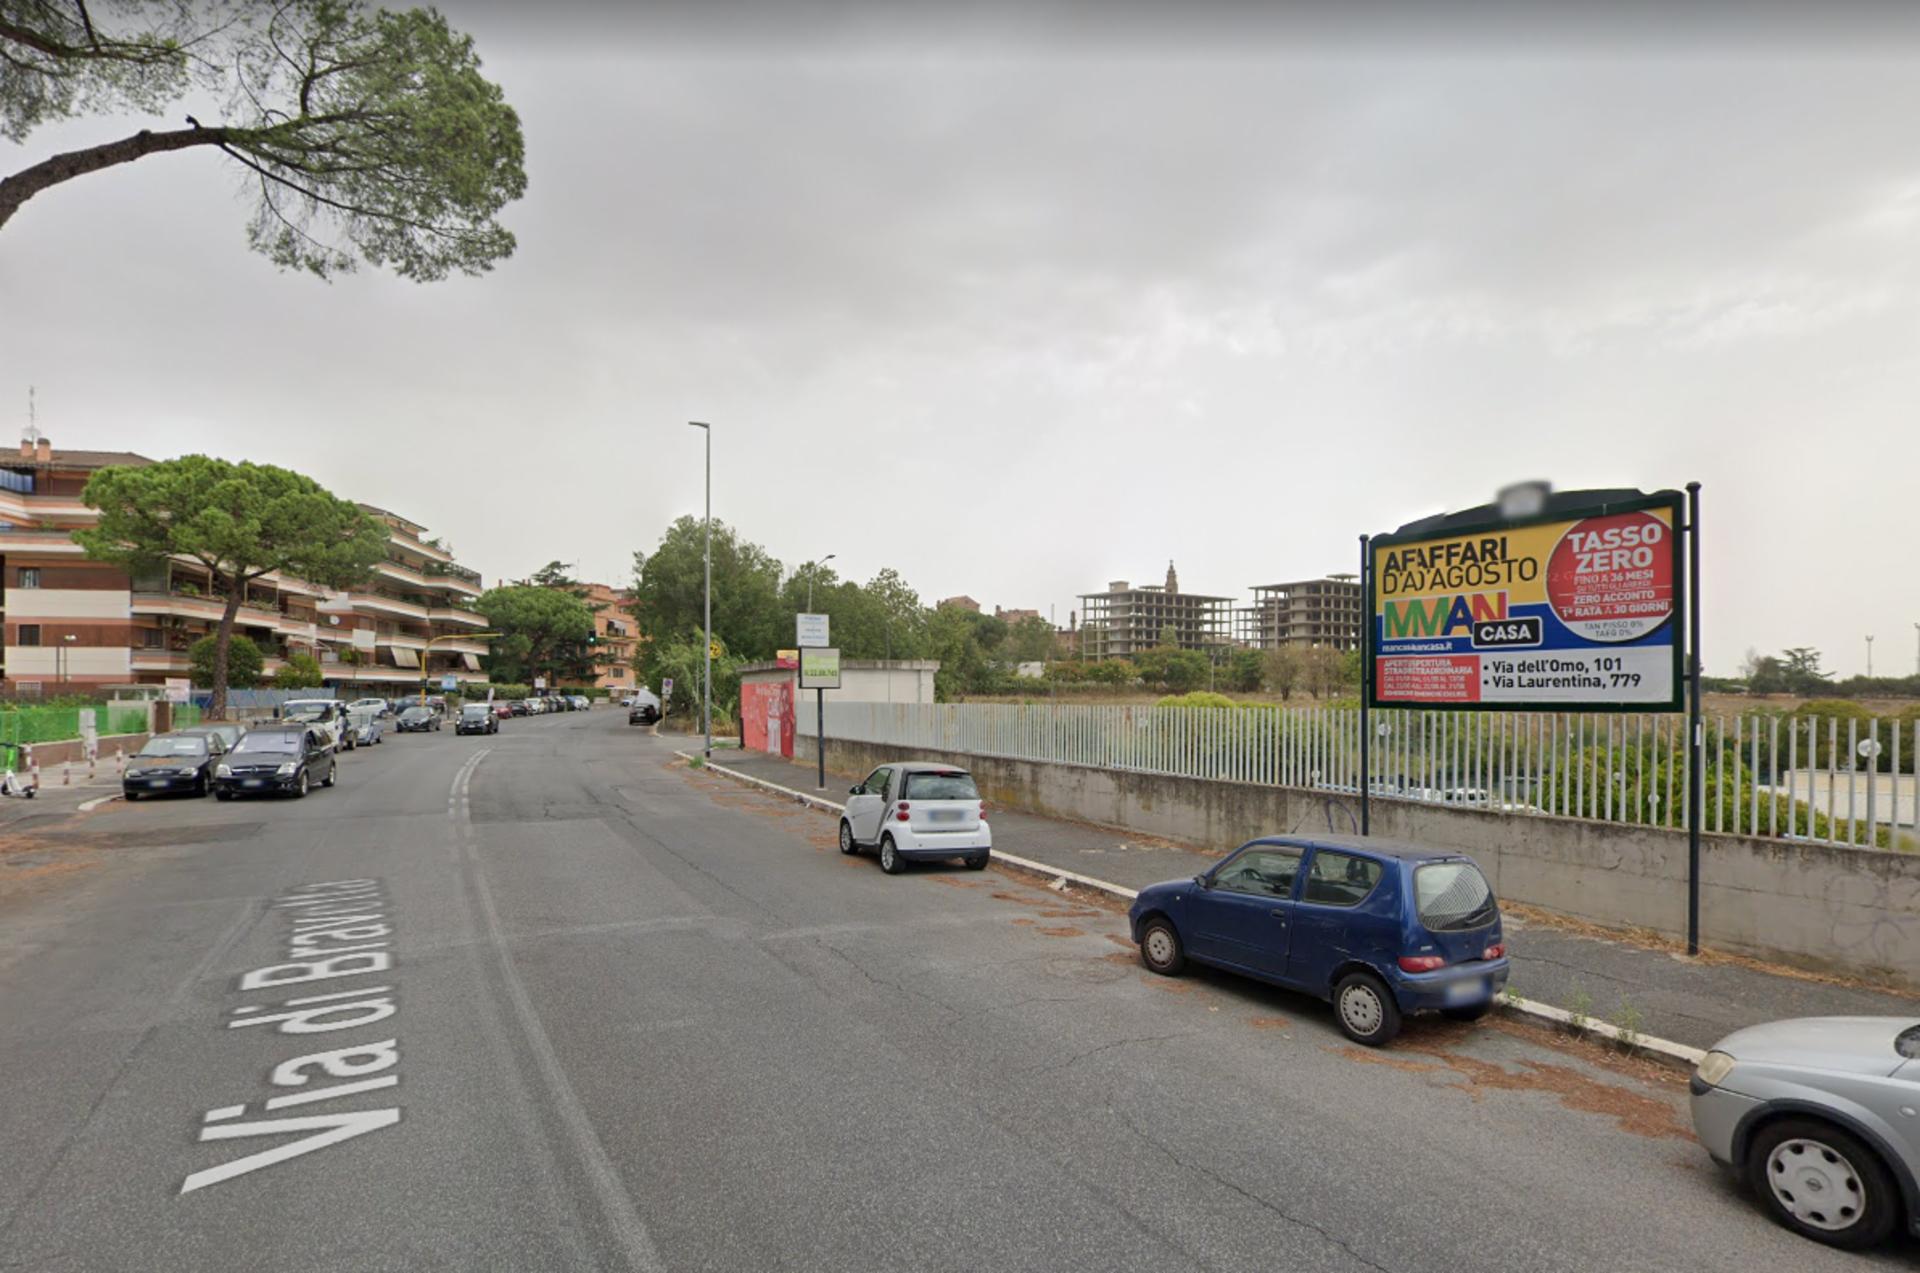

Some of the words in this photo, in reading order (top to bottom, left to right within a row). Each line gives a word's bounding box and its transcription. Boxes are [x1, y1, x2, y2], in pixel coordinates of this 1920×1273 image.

[1567, 523, 1662, 553] TASSO
[1576, 547, 1653, 574] ZERO
[1574, 575, 1599, 586] FINO
[1601, 574, 1609, 584] A
[1626, 569, 1654, 580] MESI
[1575, 594, 1600, 605] ZERO
[1603, 590, 1655, 603] ACCONTO
[1575, 605, 1602, 617] RATA
[1603, 605, 1612, 614] A
[1629, 601, 1669, 613] GIORNI
[1480, 624, 1532, 641] CASA
[1492, 660, 1514, 674] Via
[1517, 658, 1590, 674] dell'Omo,
[1594, 658, 1622, 672] 101
[1492, 675, 1514, 689] Via
[1518, 674, 1607, 690] Laurentina,
[1610, 673, 1642, 688] 779
